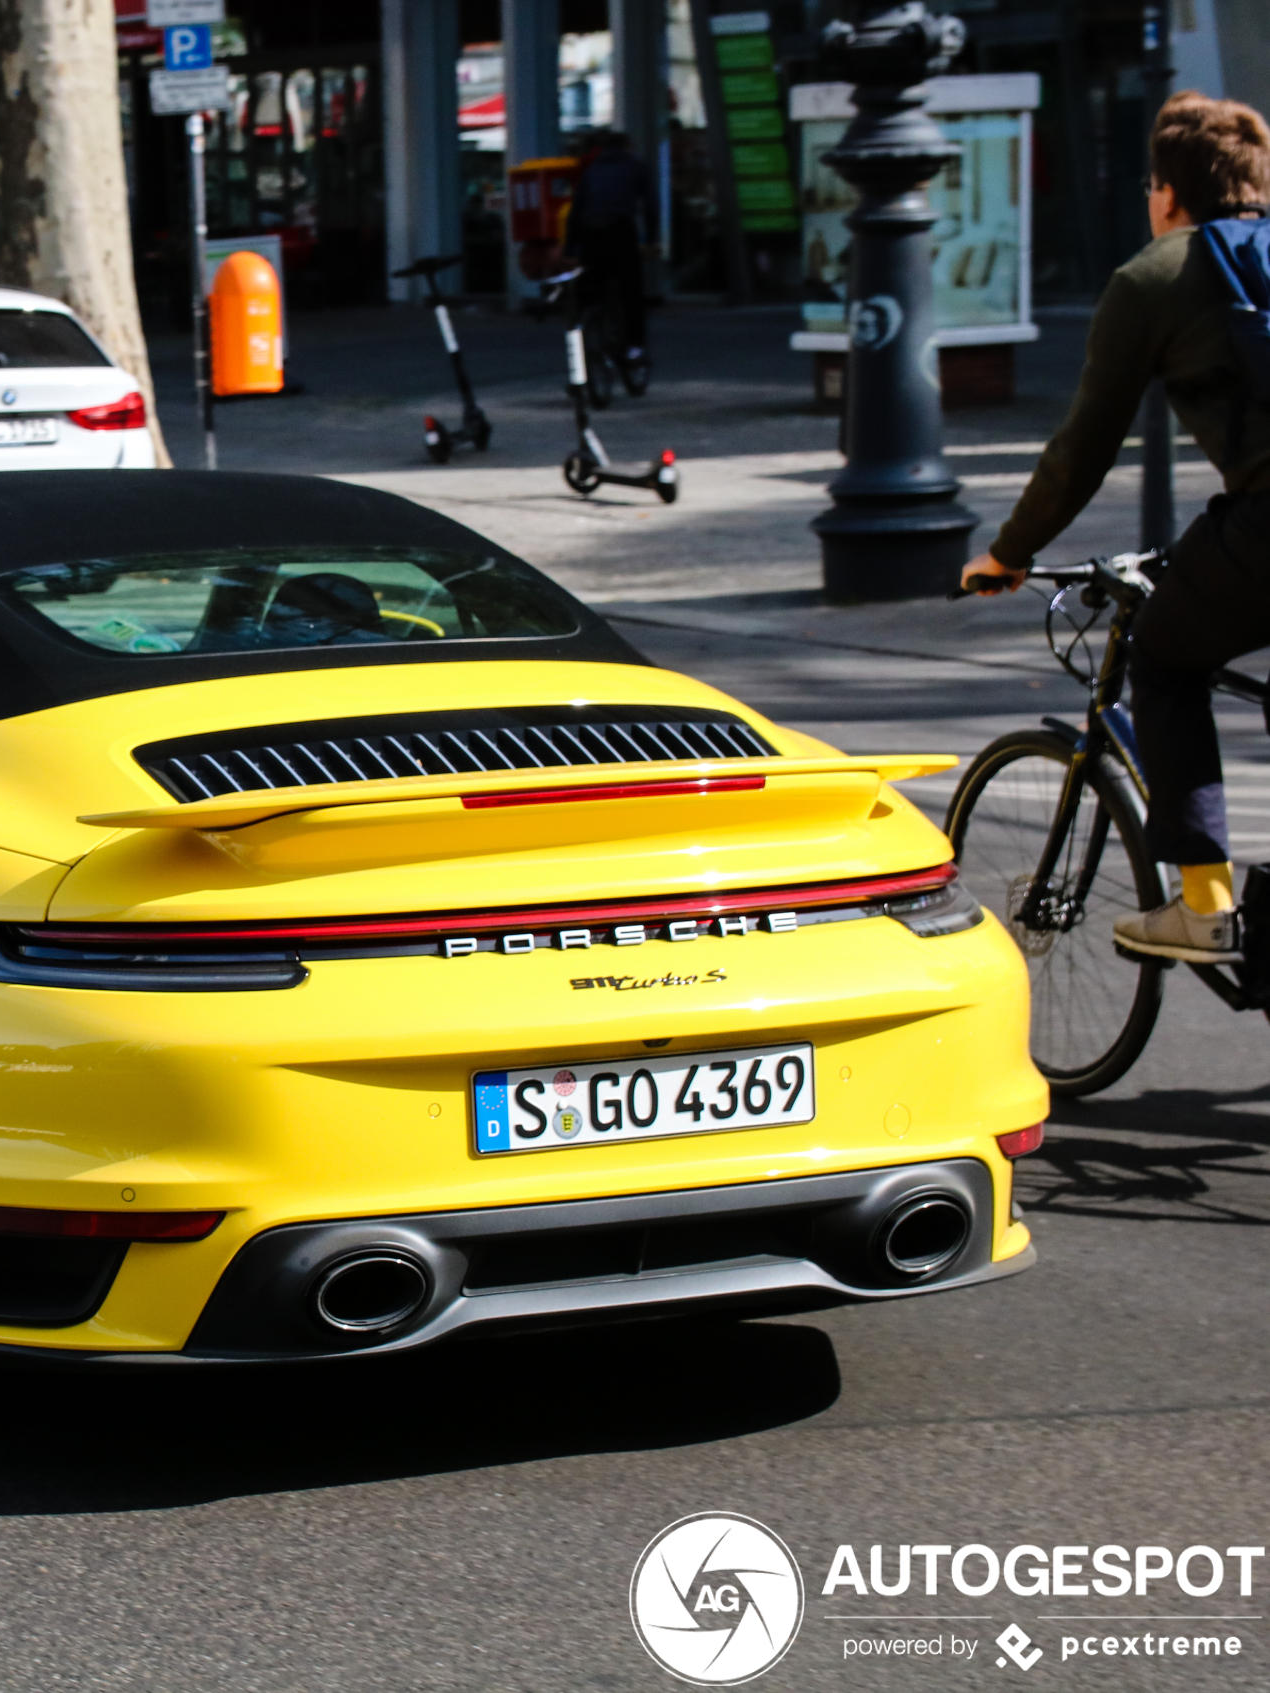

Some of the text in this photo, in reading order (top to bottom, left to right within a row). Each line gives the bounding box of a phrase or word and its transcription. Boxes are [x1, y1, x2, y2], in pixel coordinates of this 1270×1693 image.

[171, 29, 197, 65] P
[444, 911, 797, 958] PORSCHE
[701, 968, 728, 983] S
[514, 1055, 805, 1139] S GO 4369
[487, 1119, 500, 1137] D
